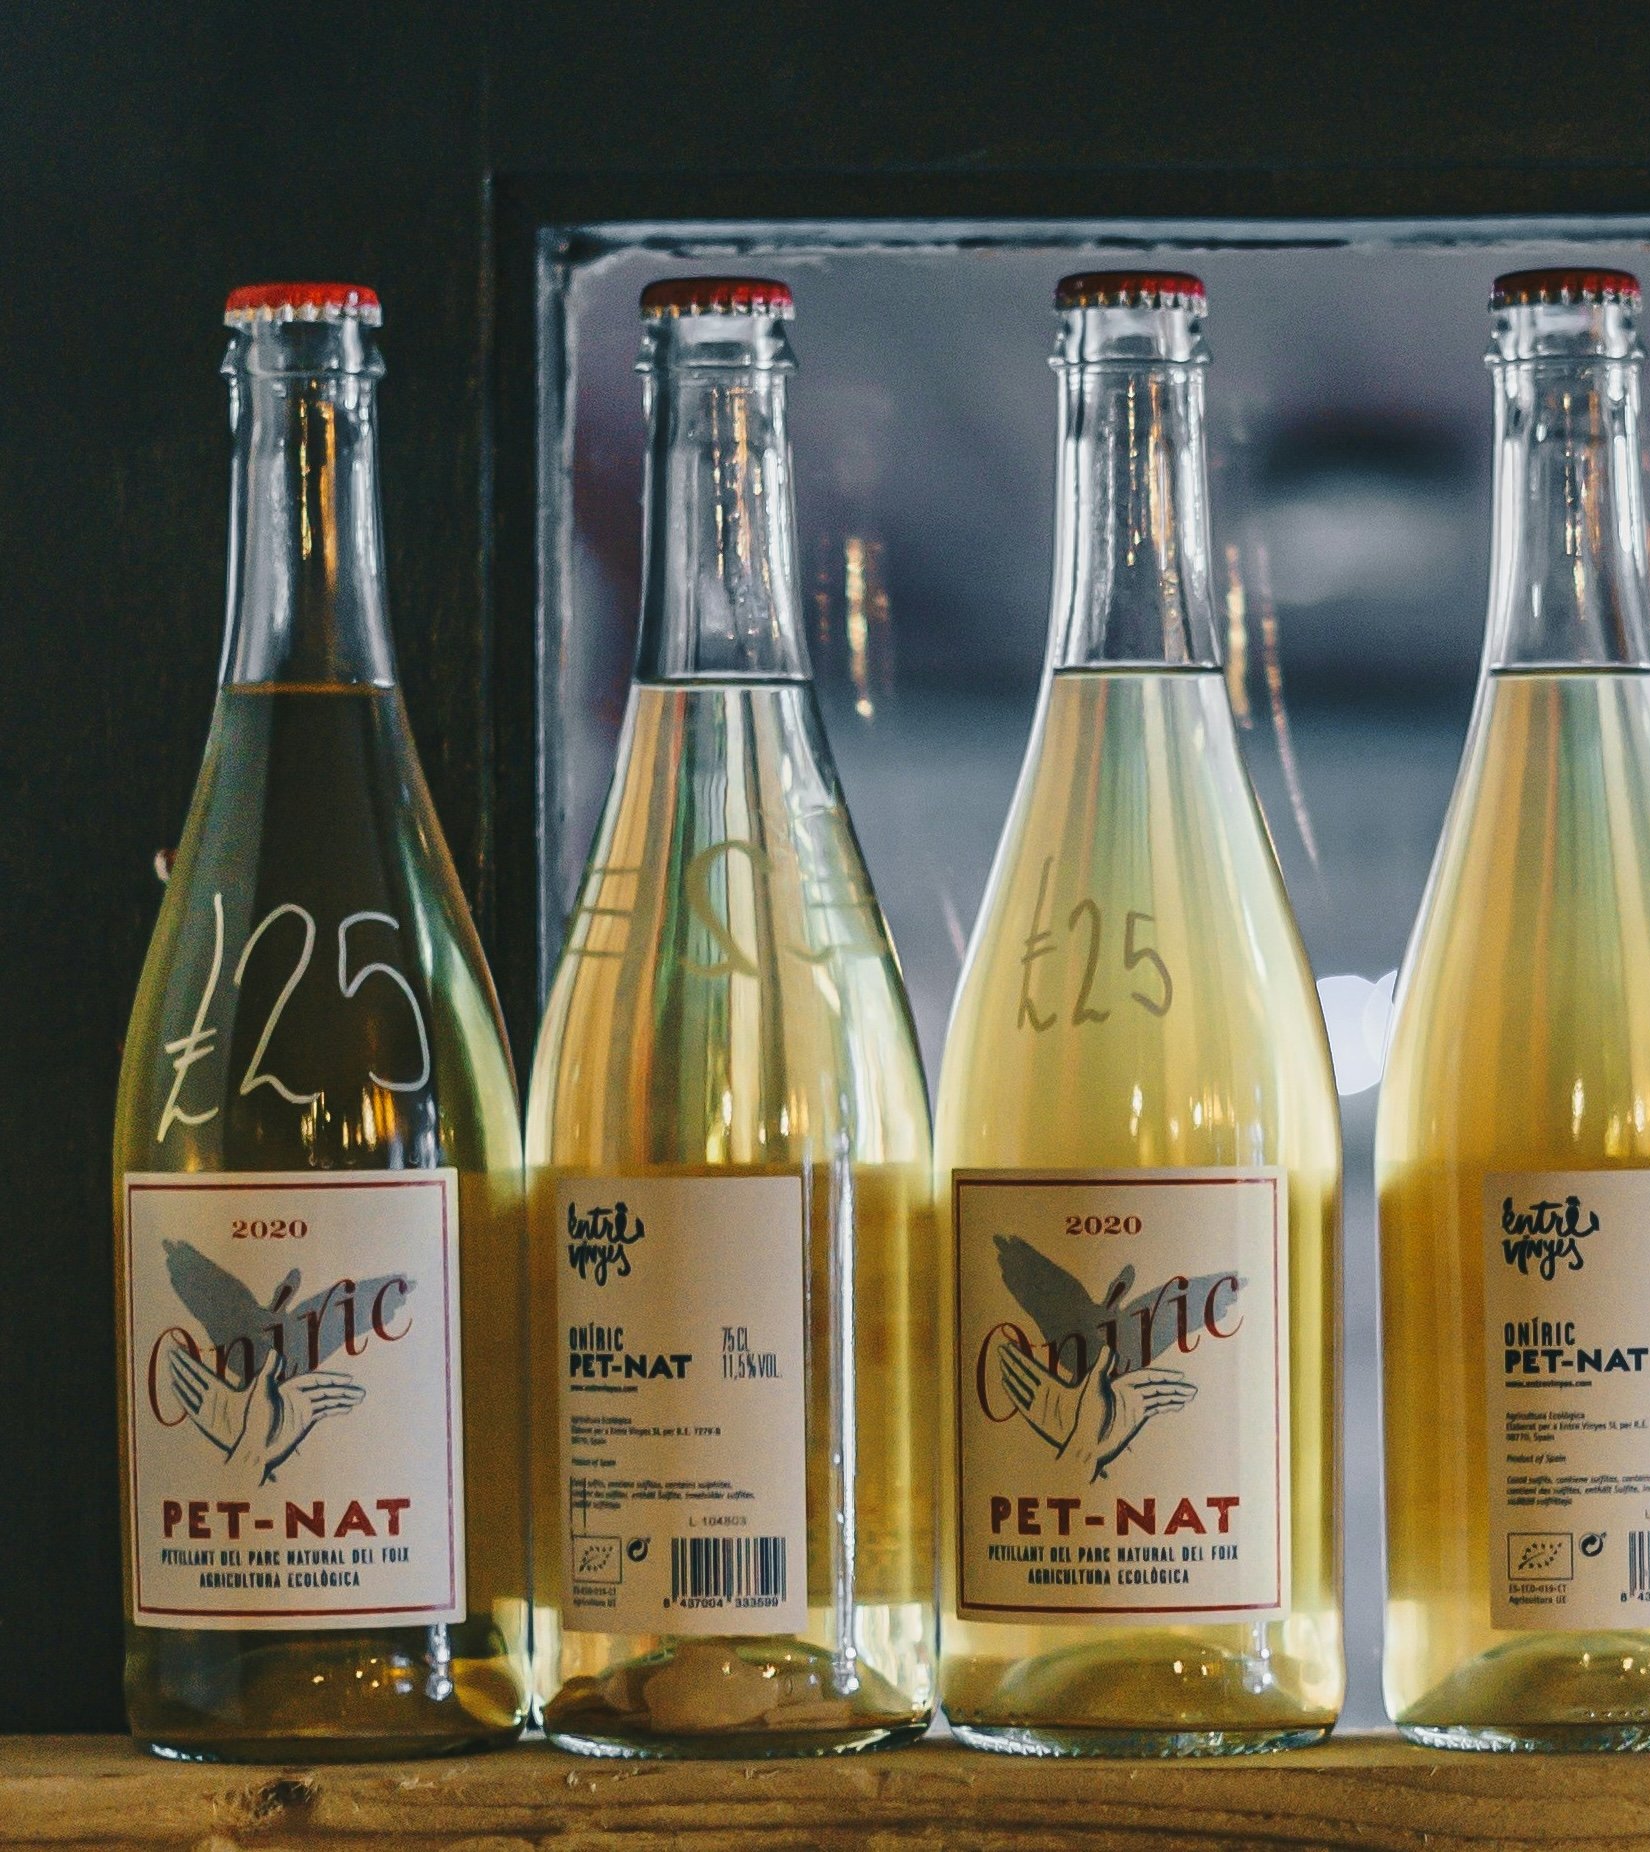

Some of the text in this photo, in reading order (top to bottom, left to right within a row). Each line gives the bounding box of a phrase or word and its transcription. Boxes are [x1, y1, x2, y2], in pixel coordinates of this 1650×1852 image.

[1017, 856, 1173, 1032] £25
[157, 892, 431, 1144] £25
[232, 1219, 308, 1240] 2020
[1065, 1215, 1142, 1235] 2020
[569, 1322, 624, 1351] ONÍRIC
[722, 1326, 735, 1352] 75
[1504, 1316, 1576, 1347] ONÍRIC
[569, 1354, 692, 1379] PET-NAT
[1504, 1347, 1649, 1374] PET-NAT
[163, 1498, 411, 1539] PET-NAT
[991, 1496, 1240, 1536] PET-NAT
[220, 1549, 241, 1566] DEL
[249, 1550, 280, 1566] PARC
[287, 1549, 345, 1566] NATURAL
[352, 1548, 374, 1565] DEL
[381, 1547, 409, 1563] FOIX
[988, 1545, 1238, 1563] PETILLANT DEL PARC NATURAL DEL FOIX
[199, 1571, 281, 1588] AGRICULTURA
[1028, 1568, 1111, 1585] AGRICULTURA
[680, 1598, 723, 1608] 437004
